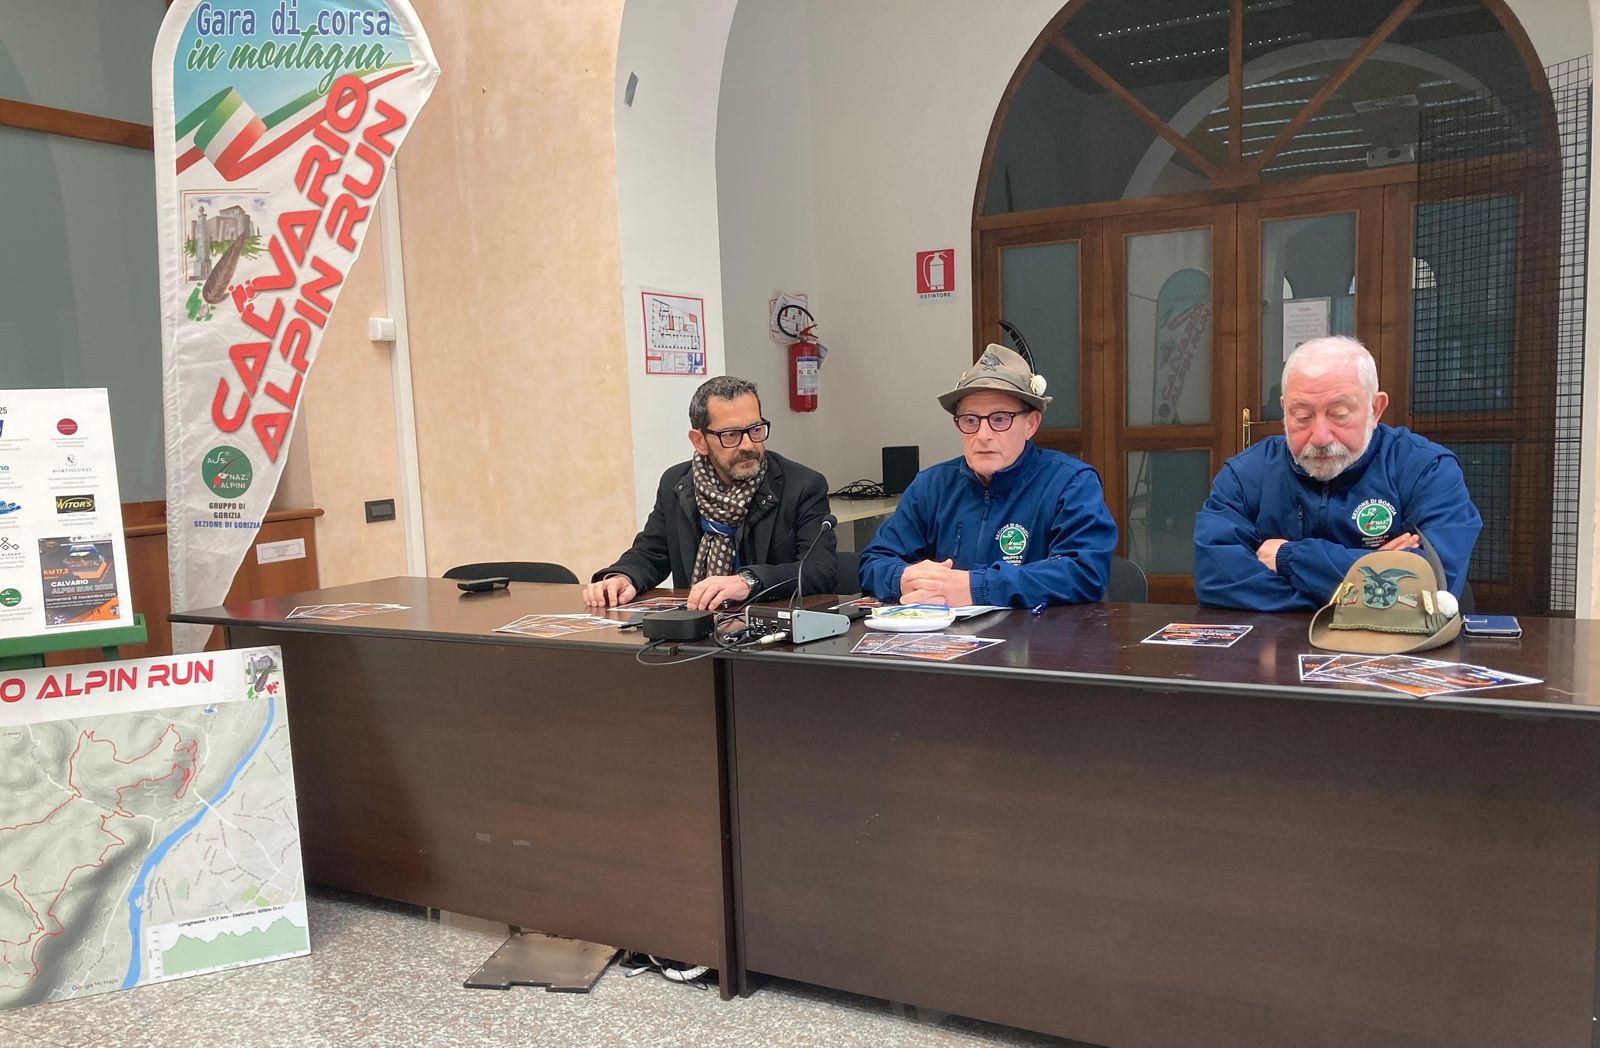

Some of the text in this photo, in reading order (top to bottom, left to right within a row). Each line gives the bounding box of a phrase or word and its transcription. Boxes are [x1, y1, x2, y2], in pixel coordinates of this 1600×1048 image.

[197, 1, 391, 36] Gara di corsa
[187, 24, 393, 96] in montagna
[211, 74, 369, 433] CALVARIO
[252, 256, 343, 464] ALPIN
[325, 99, 407, 253] RUN
[229, 473, 248, 481] NAZ.
[208, 502, 246, 510] GRUPPO DI
[1351, 500, 1368, 520] SEZIONE
[1378, 499, 1397, 516] GORIZIA
[193, 520, 261, 529] SEZIONE DI GORIZIA
[50, 579, 89, 588] CALVARIO
[35, 667, 138, 700] ALPIN
[147, 659, 214, 689] RUN
